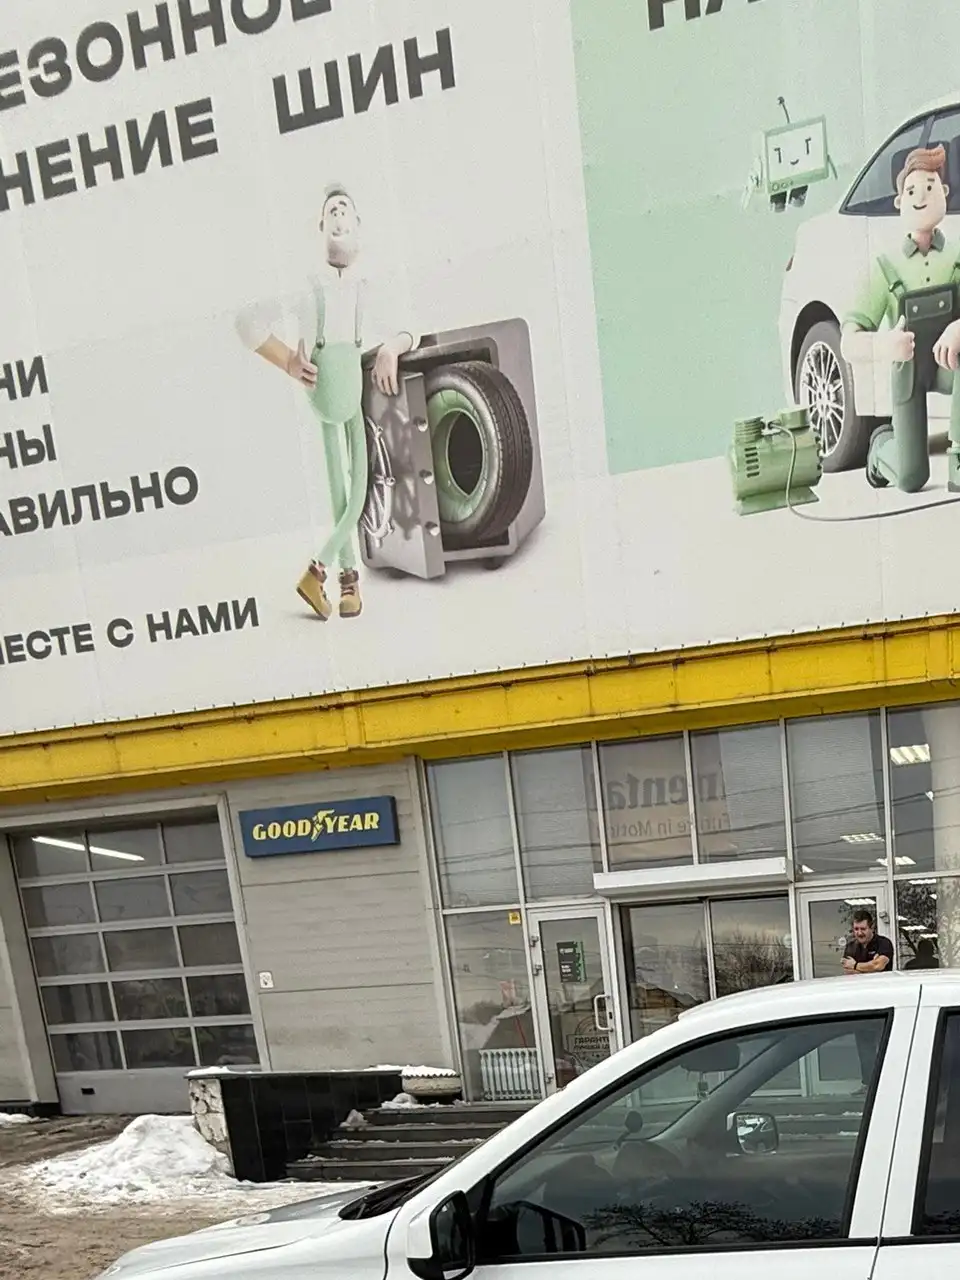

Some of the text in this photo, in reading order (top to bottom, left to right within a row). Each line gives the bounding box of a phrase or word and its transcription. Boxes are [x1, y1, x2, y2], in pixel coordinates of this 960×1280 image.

[271, 27, 456, 135] ШИН
[0, 597, 259, 665] ЕСТЕ С НАМИ
[252, 810, 380, 842] GOODYEAR
